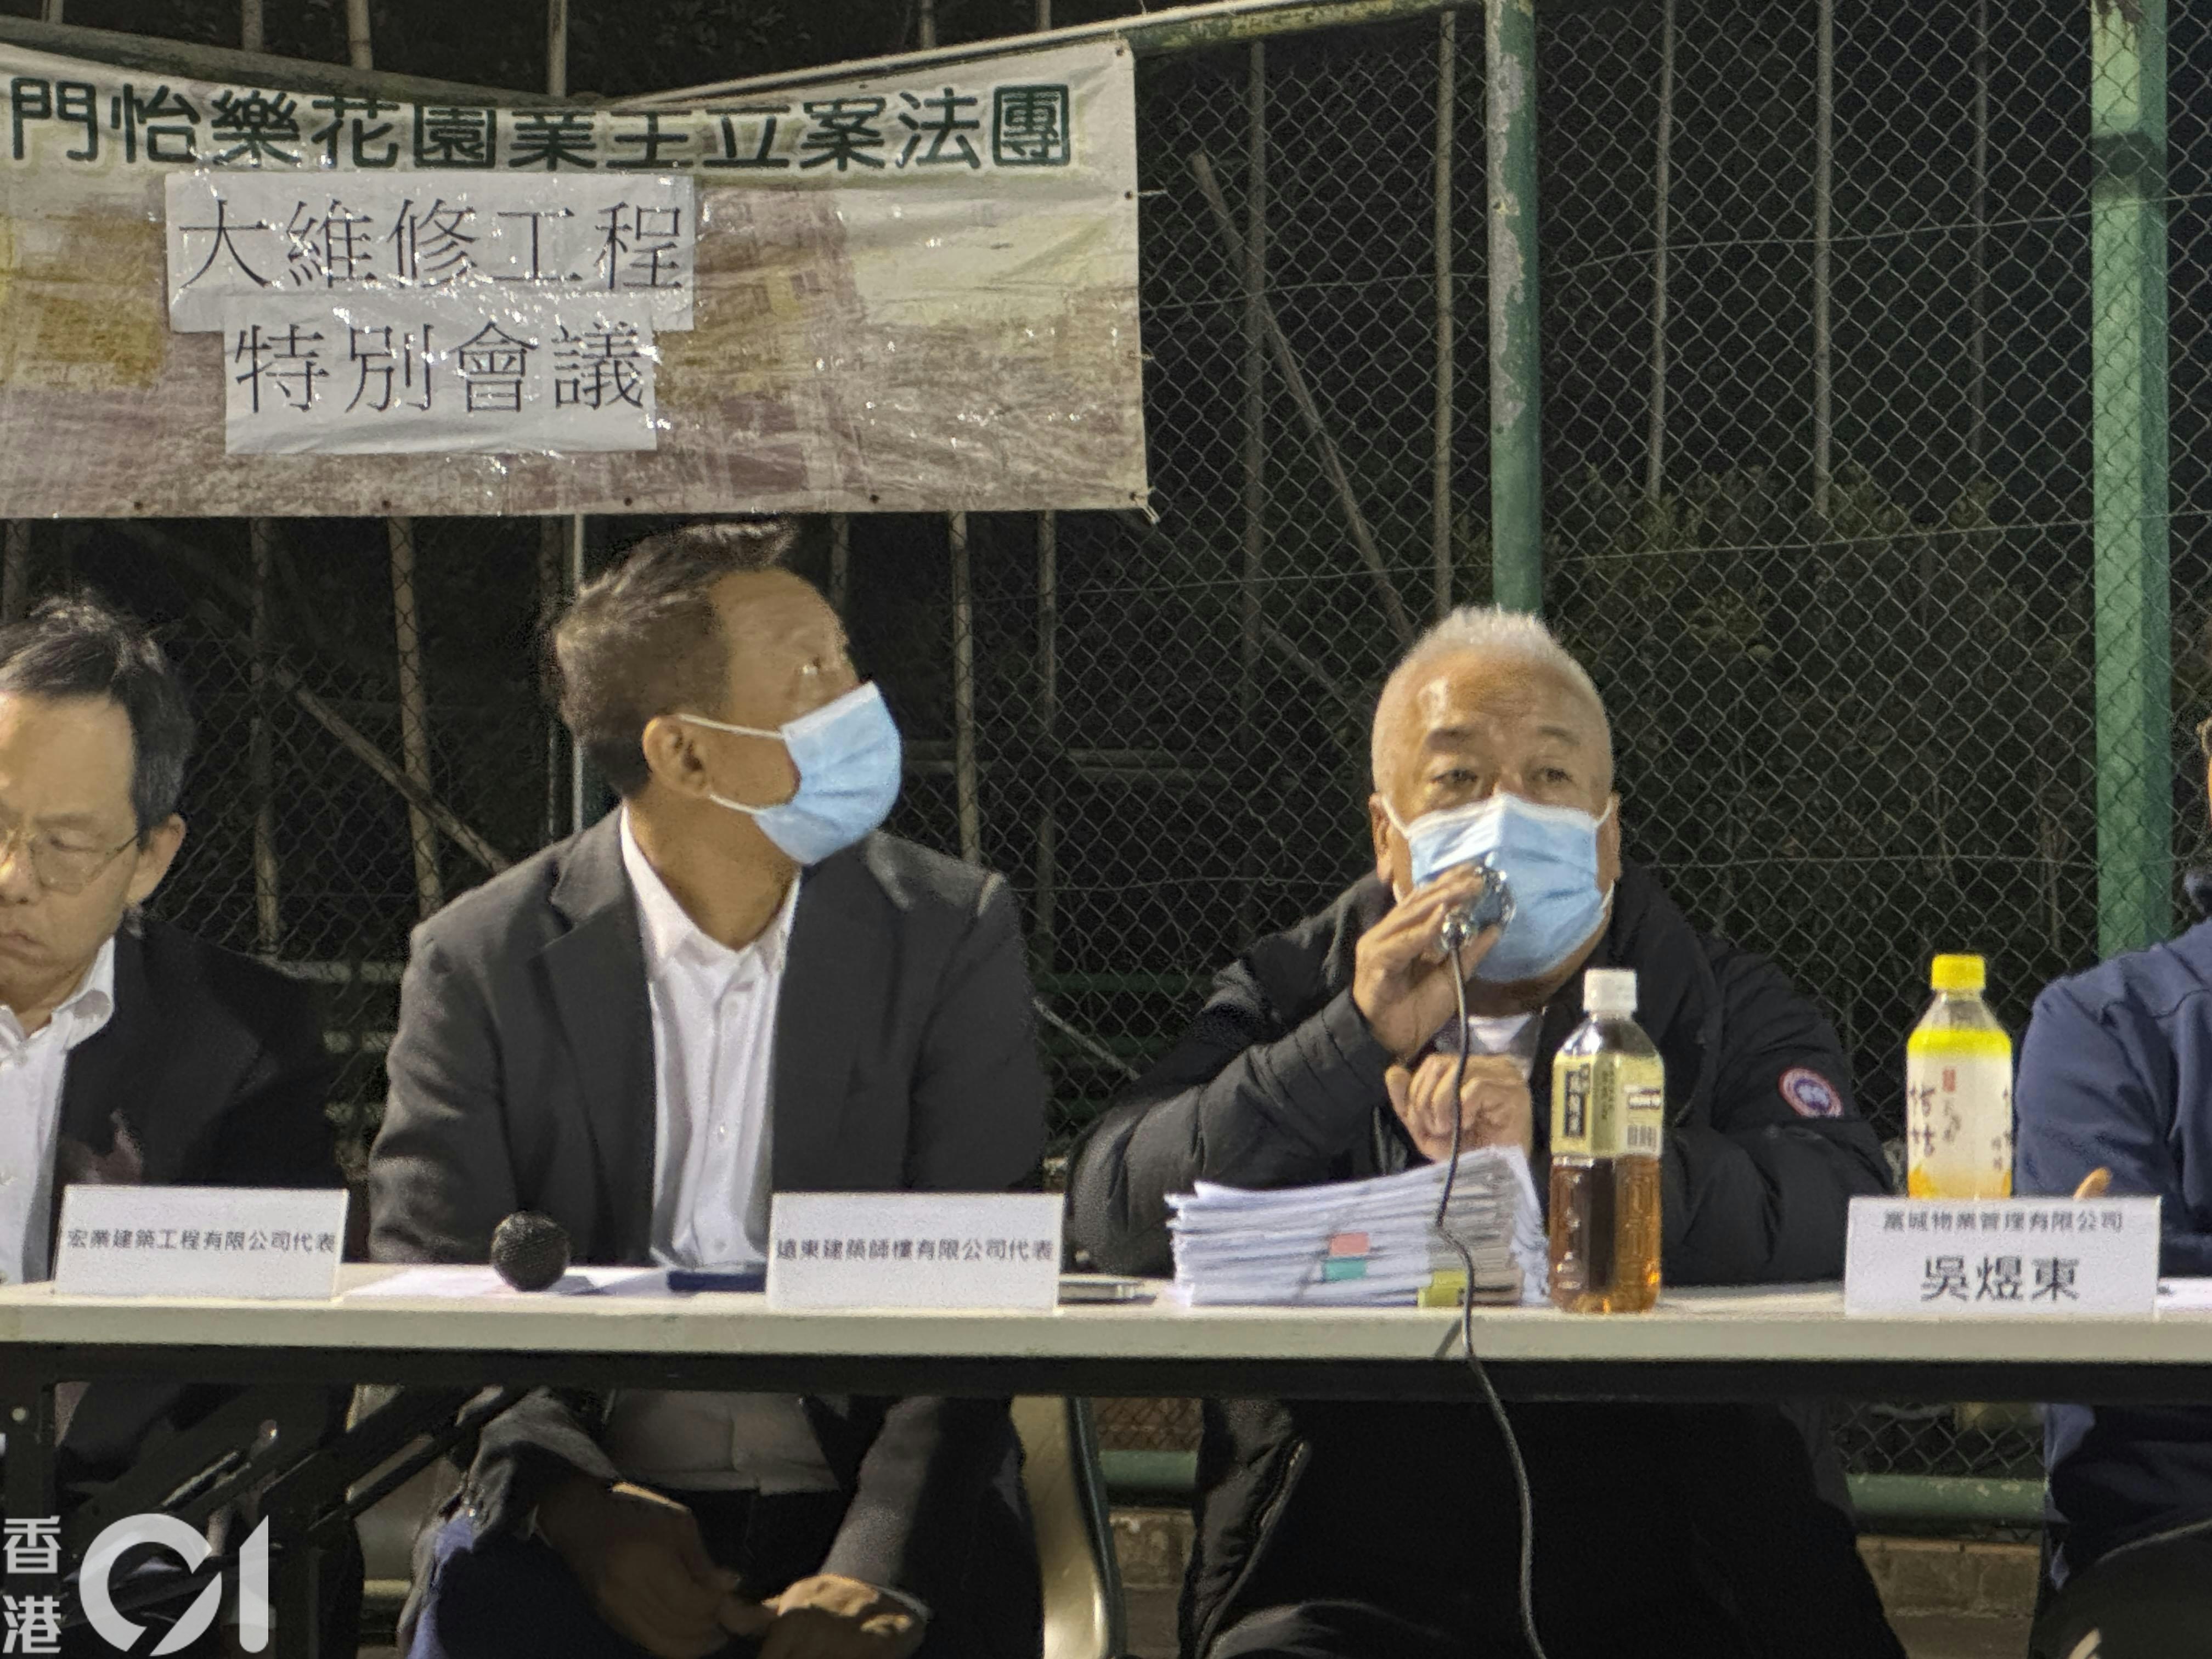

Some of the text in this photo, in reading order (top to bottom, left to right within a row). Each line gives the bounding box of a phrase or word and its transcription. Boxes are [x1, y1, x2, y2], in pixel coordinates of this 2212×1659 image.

[11, 78, 1070, 171] 門怡樂花園業主立案法團
[178, 198, 683, 290] 大維修工程
[235, 320, 644, 414] 特別會議
[1920, 1254, 2080, 1301] 吳煜東
